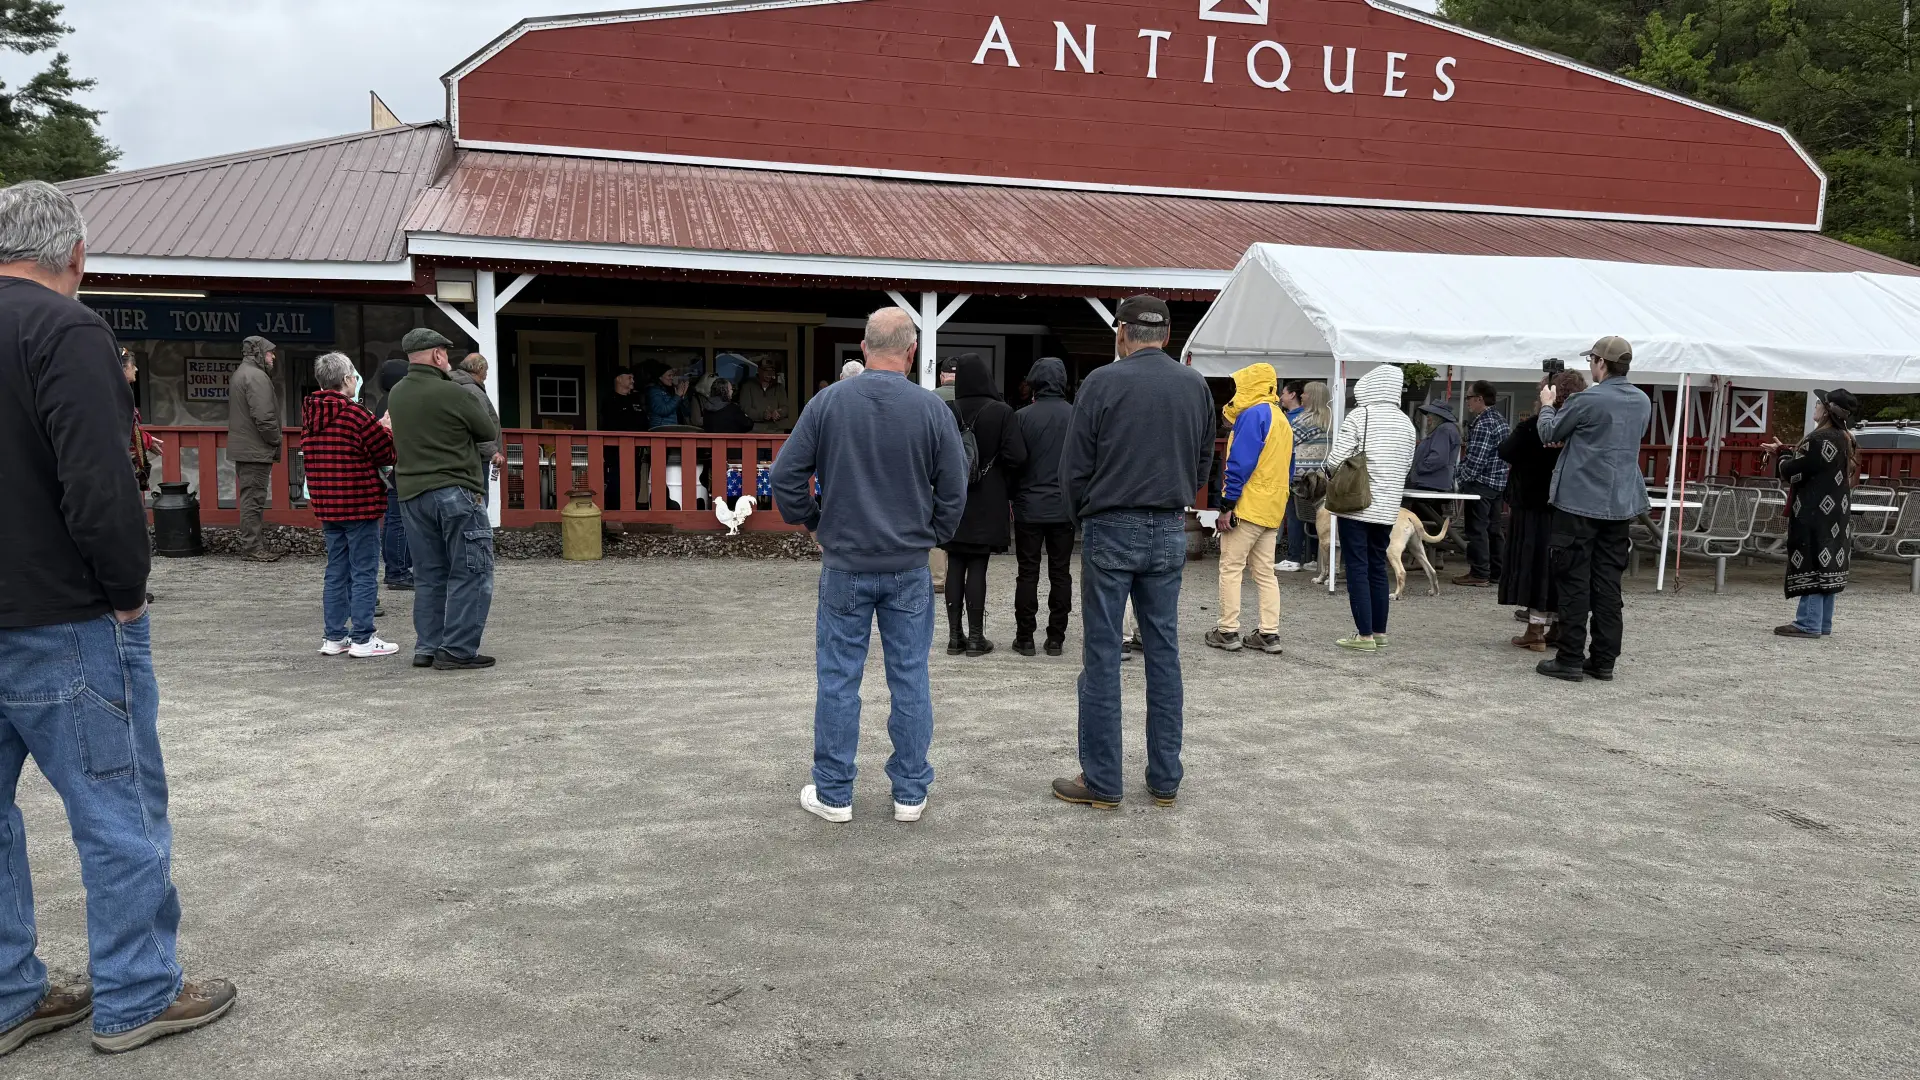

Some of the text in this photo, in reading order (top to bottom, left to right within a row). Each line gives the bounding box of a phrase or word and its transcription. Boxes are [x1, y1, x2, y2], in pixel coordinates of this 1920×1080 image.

[971, 15, 1457, 102] ANTIQUES
[94, 307, 311, 334] TIER TOWN JAIL
[187, 374, 216, 385] JOHN
